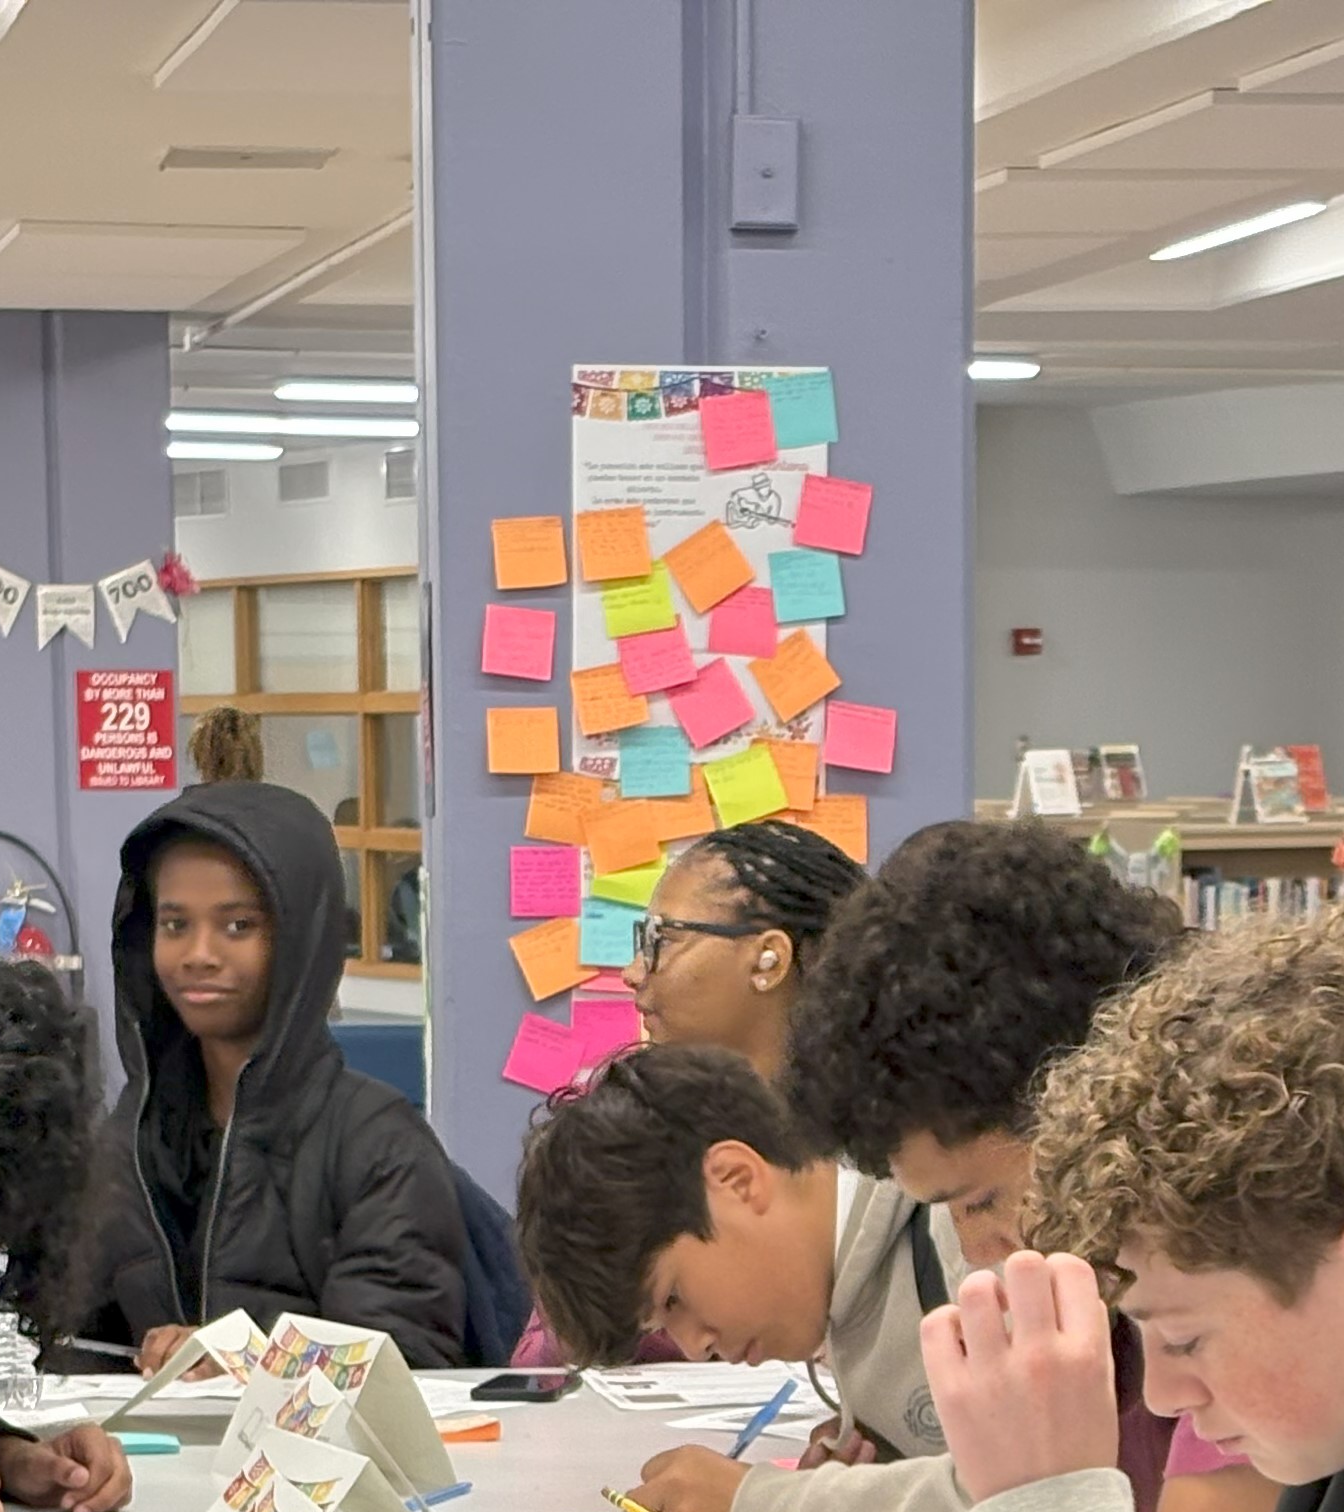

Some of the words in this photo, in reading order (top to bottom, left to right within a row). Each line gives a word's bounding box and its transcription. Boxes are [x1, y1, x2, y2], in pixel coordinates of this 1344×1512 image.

[108, 573, 153, 605] 700
[91, 672, 158, 686] OCCUPANCY
[84, 687, 101, 701] BY
[101, 687, 134, 700] MORE
[135, 687, 166, 700] THAN
[100, 702, 151, 731] 229
[93, 731, 145, 745] PERSONS
[81, 746, 148, 760] DANGEROUS
[149, 746, 173, 759] AND
[97, 762, 156, 775] UNLAWFUL
